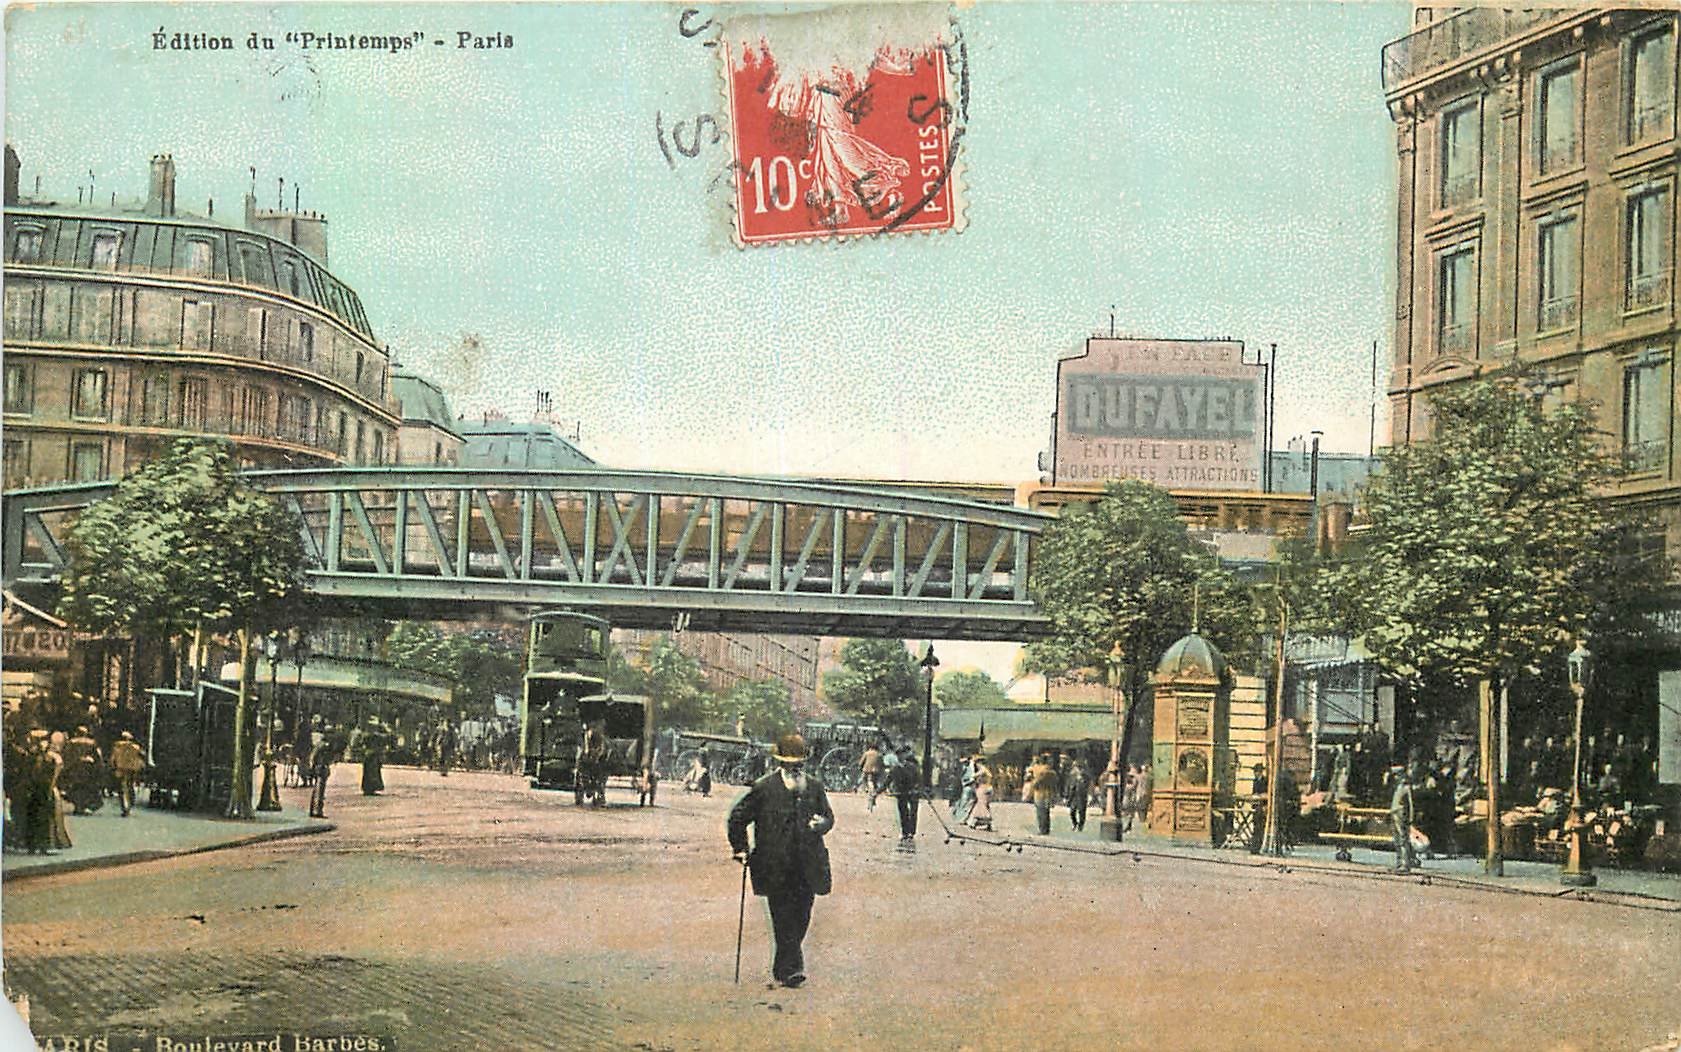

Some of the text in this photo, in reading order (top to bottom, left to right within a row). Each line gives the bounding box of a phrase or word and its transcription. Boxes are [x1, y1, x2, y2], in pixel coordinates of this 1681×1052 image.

[918, 124, 943, 213] POSTES
[1075, 383, 1253, 432] DUFAYEL
[1083, 441, 1164, 461] ENTRÉE
[1167, 467, 1258, 484] ATTRACTIONS
